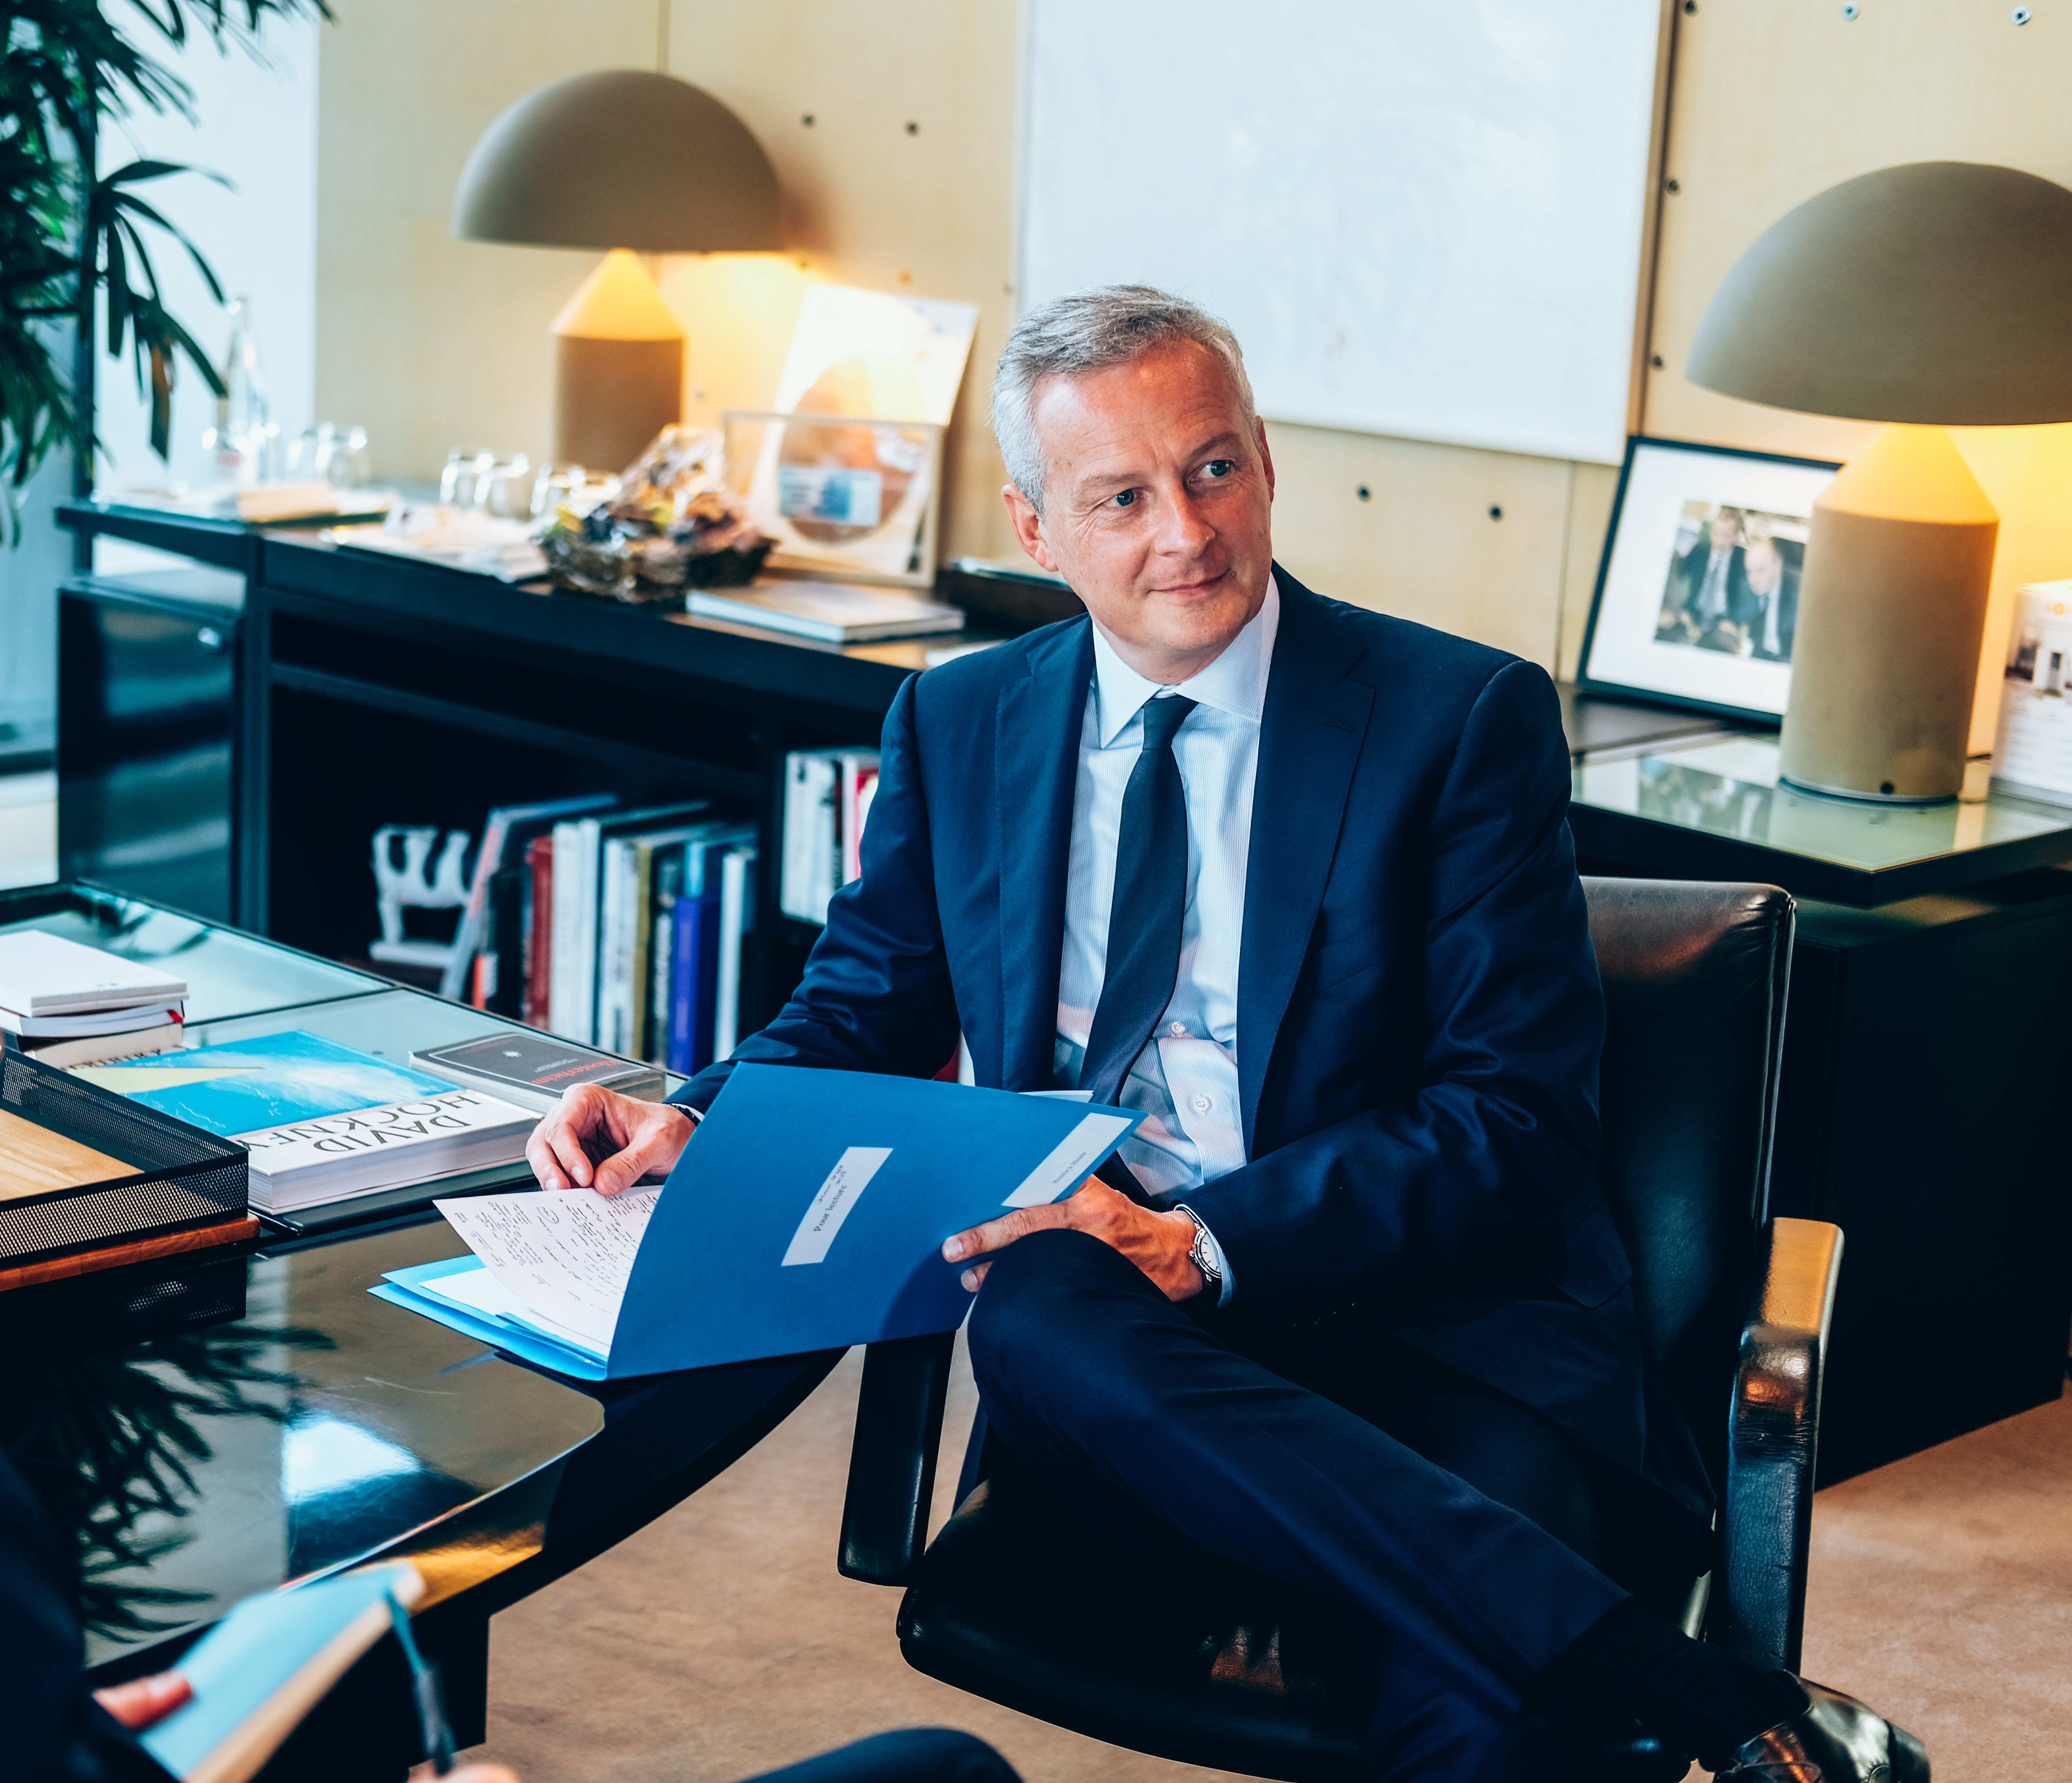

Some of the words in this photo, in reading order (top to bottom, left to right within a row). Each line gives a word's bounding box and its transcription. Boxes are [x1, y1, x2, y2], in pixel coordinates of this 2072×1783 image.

[235, 1095, 481, 1151] HOCKNEY
[313, 1115, 472, 1152] DAVID
[813, 1213, 830, 1231] Pour
[825, 1184, 847, 1211] lecture
